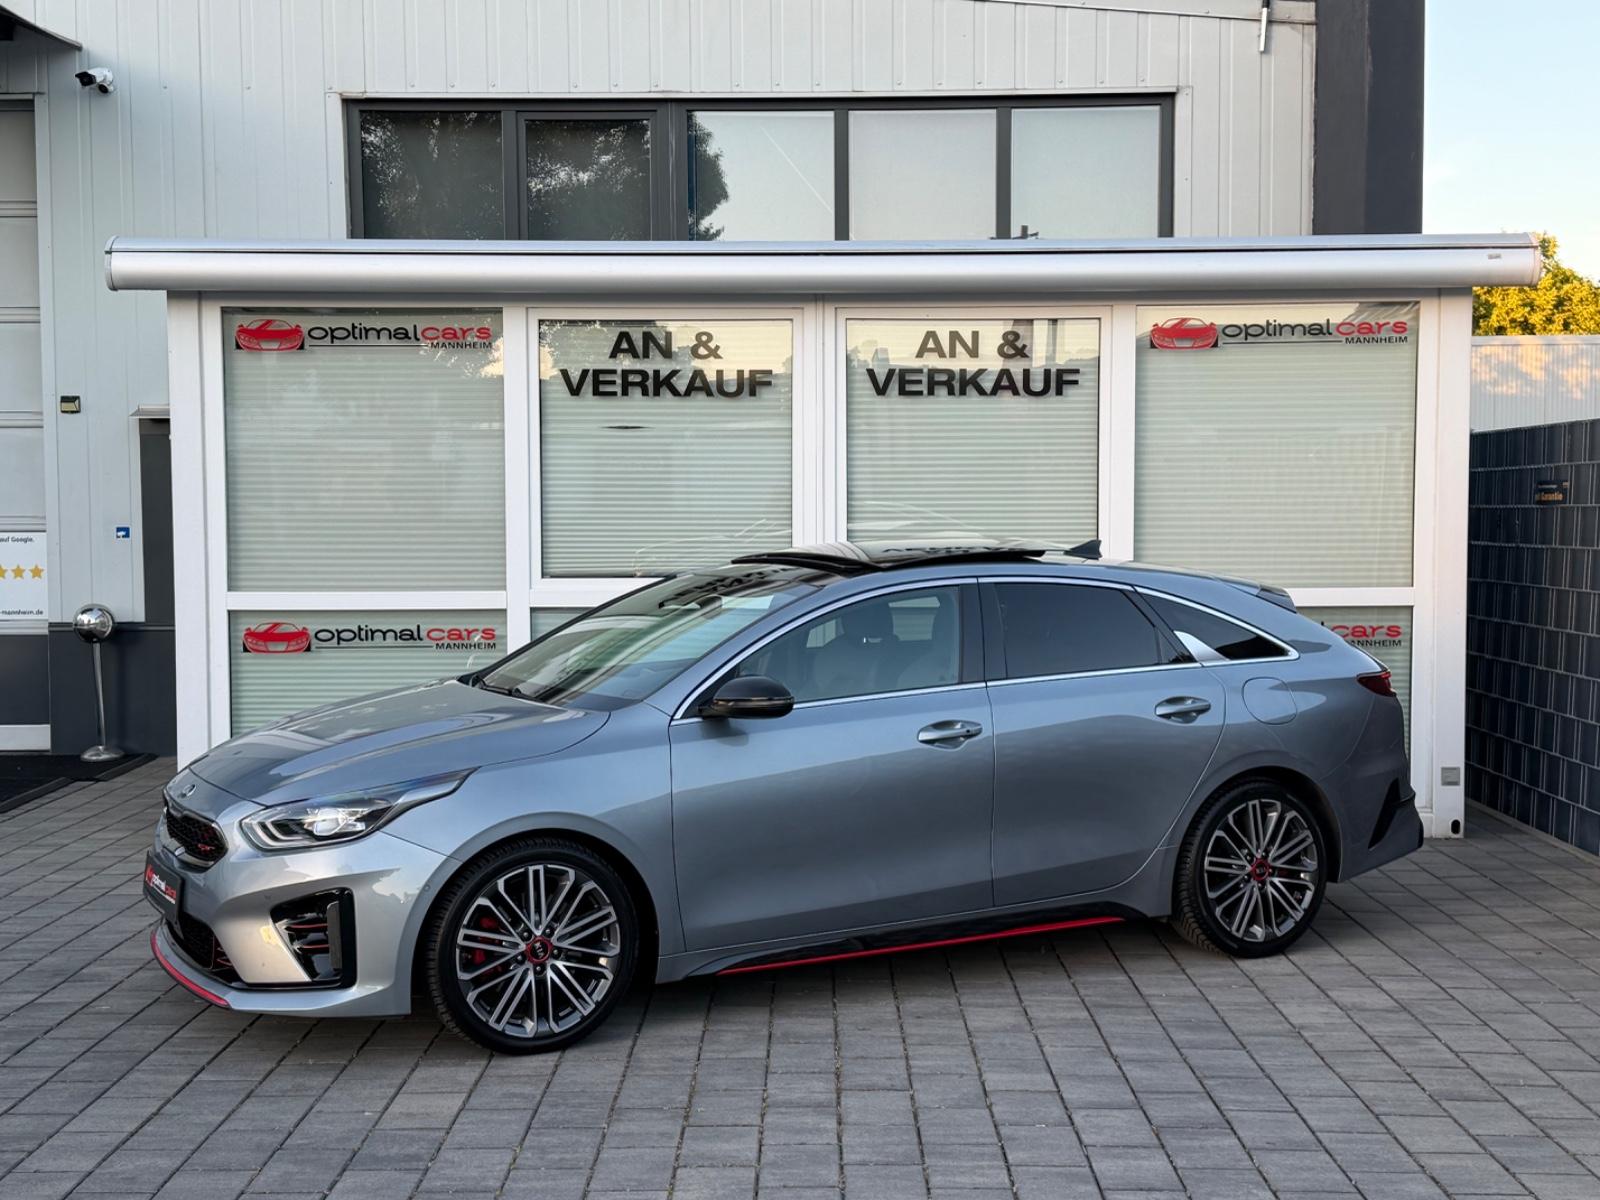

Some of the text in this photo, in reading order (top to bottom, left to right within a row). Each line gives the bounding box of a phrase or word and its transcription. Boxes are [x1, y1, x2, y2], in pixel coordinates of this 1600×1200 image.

[430, 341, 492, 349] MANNHEIM
[609, 331, 723, 360] AN &
[915, 330, 1030, 359] AN &
[1345, 335, 1408, 345] MANNHEIM
[560, 369, 773, 397] VERKAUF
[866, 368, 1080, 396] VERKAUF
[435, 642, 496, 650] MANNHEIM
